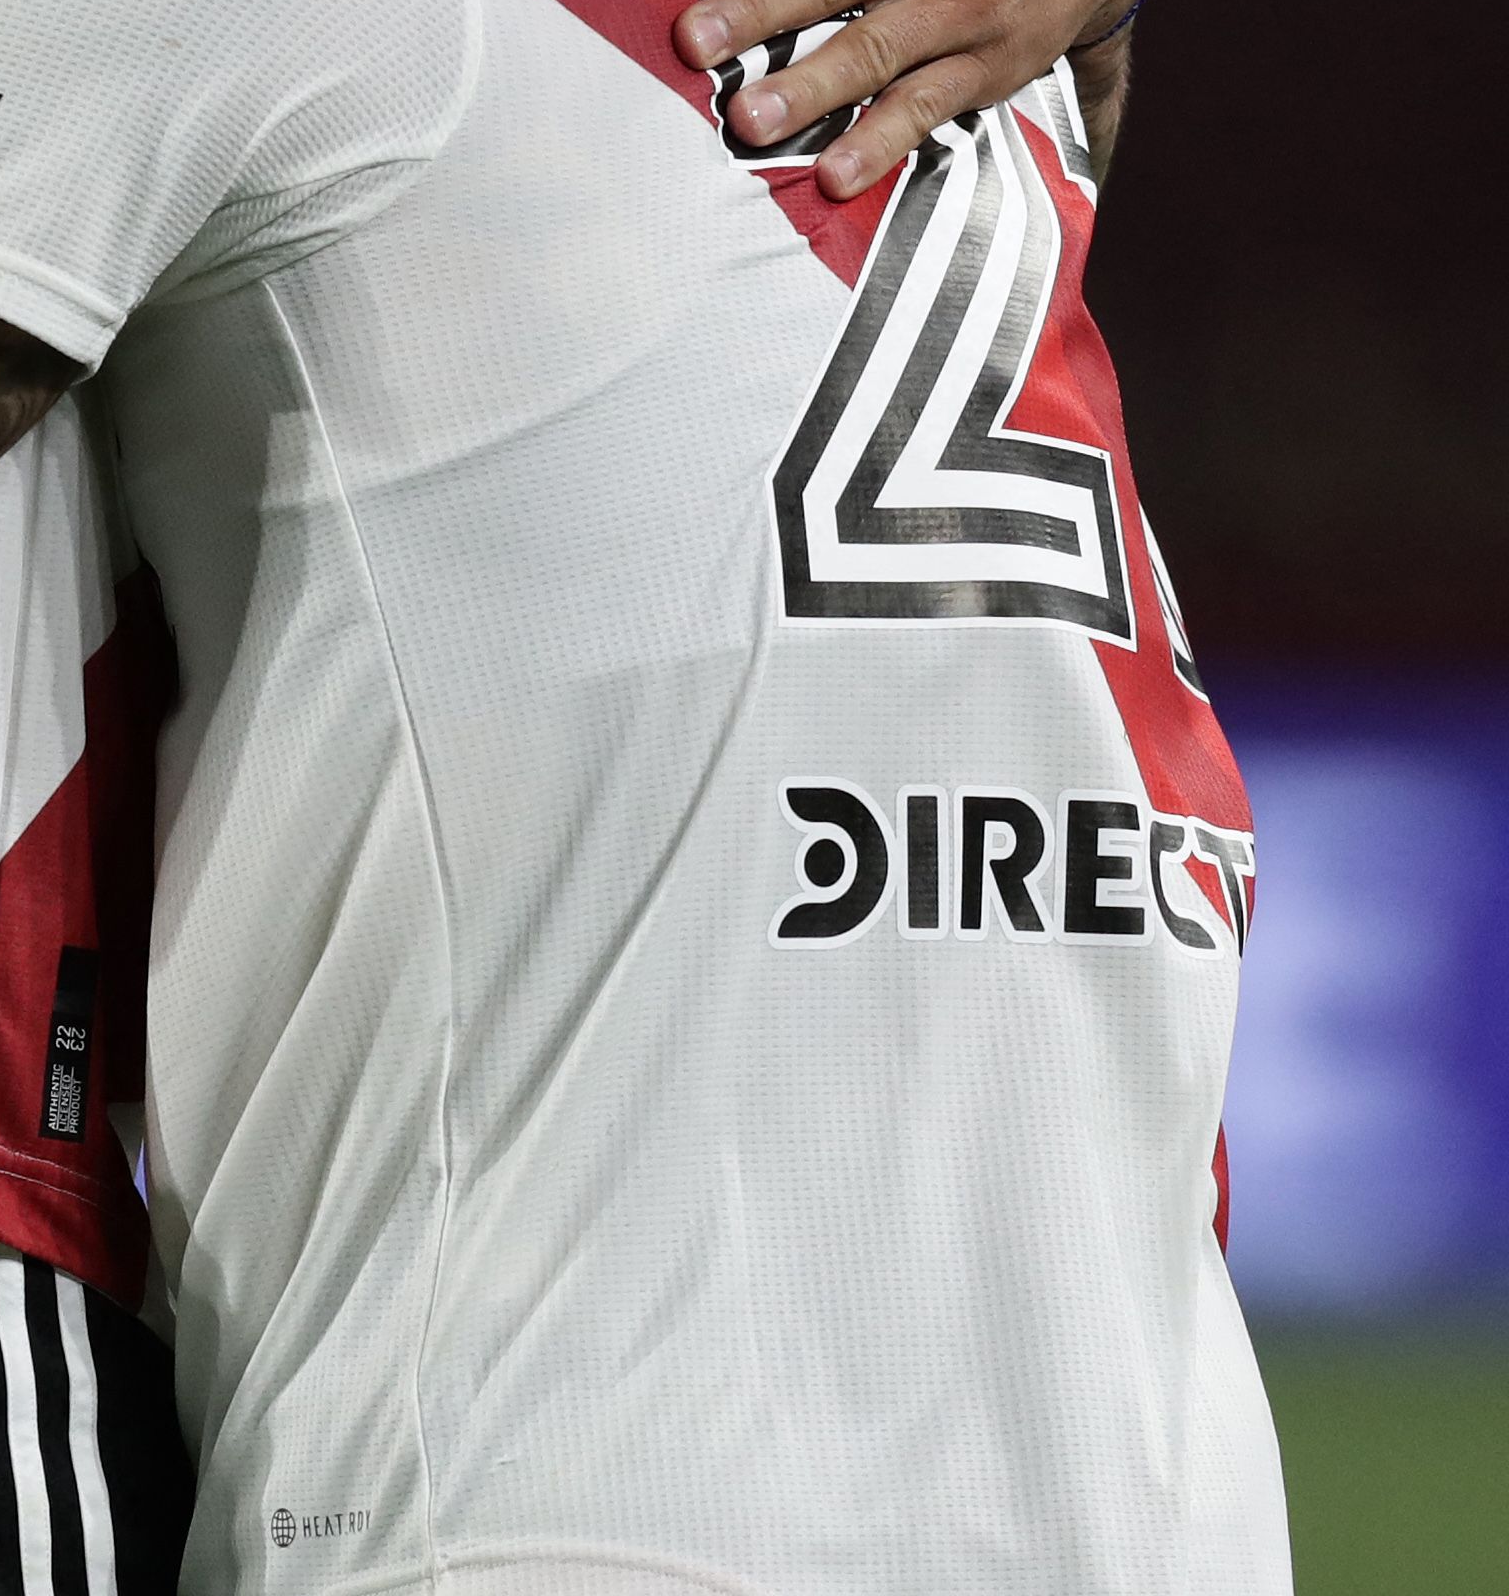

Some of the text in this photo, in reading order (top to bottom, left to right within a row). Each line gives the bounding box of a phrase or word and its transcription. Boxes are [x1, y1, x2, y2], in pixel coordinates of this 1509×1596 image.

[773, 782, 1256, 959] DIRECT
[55, 1025, 72, 1050] 22
[70, 1026, 86, 1051] 23
[48, 1064, 62, 1130] AUTHENTIC
[59, 1074, 71, 1132] LICENSED
[69, 1080, 82, 1134] PRODUCT
[302, 1509, 371, 1538] HEAT.RDY
